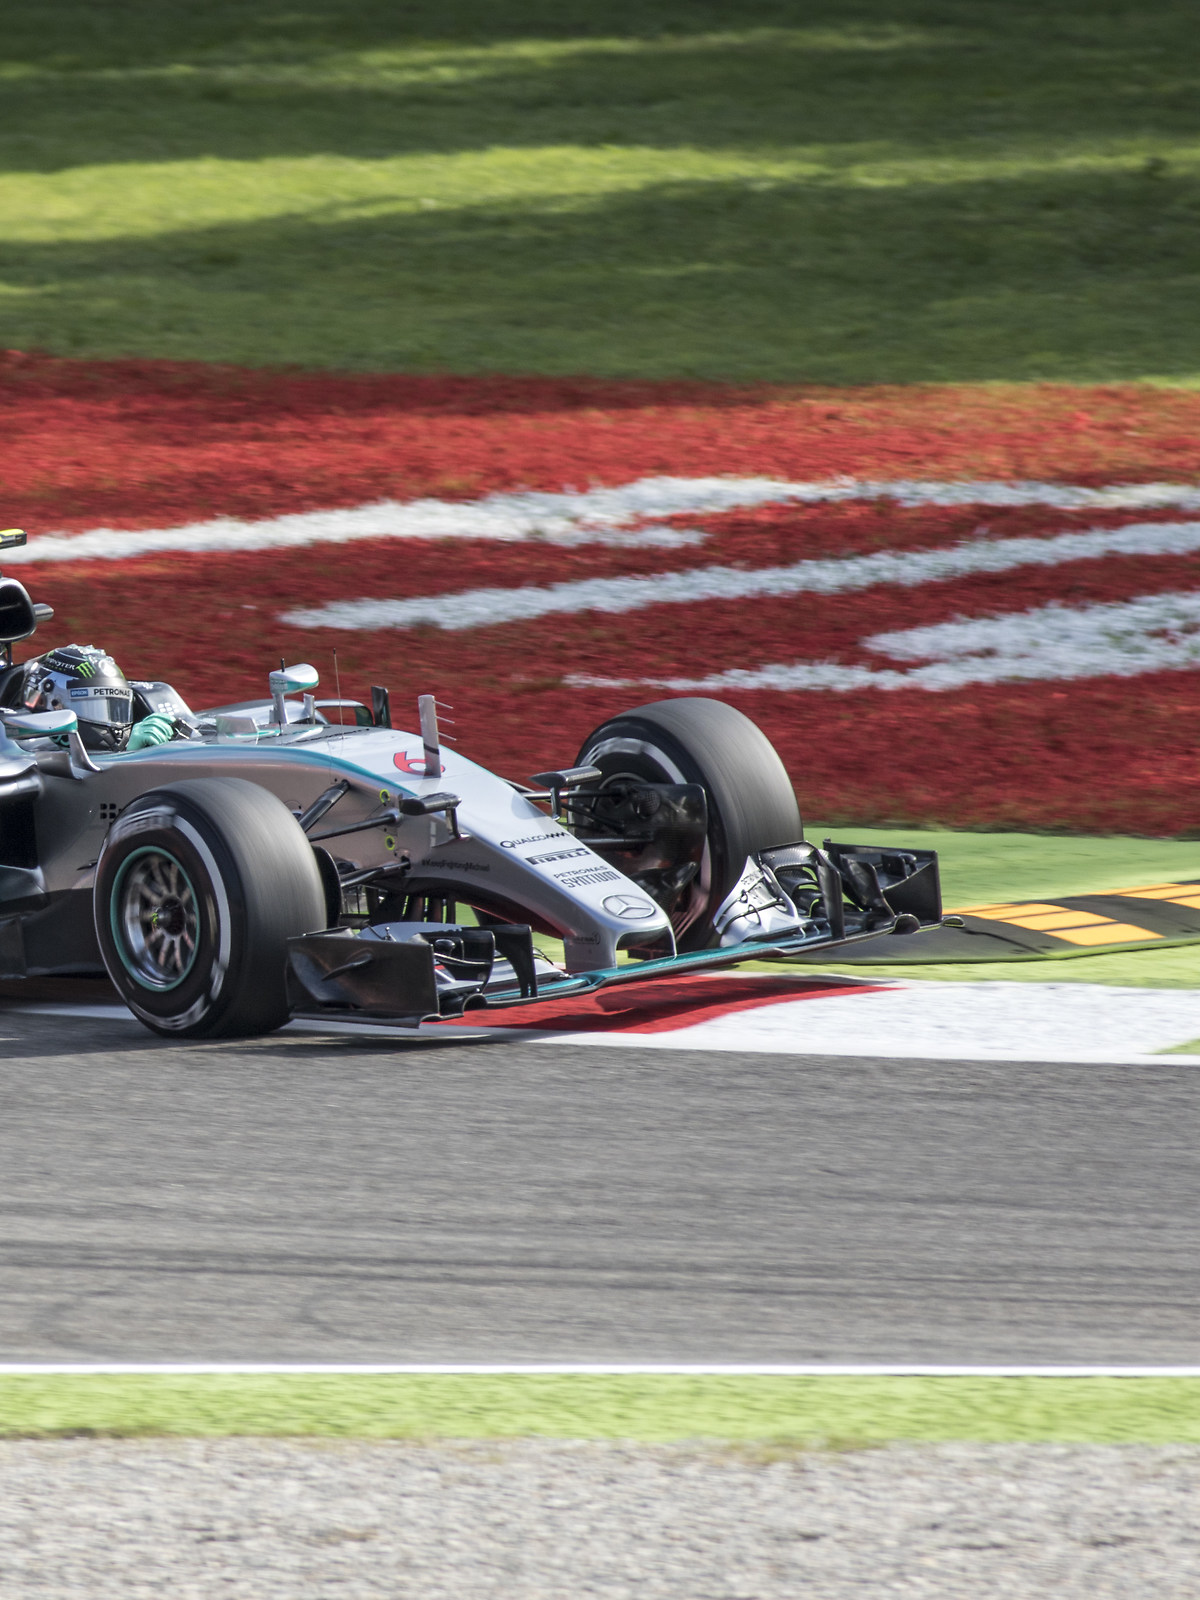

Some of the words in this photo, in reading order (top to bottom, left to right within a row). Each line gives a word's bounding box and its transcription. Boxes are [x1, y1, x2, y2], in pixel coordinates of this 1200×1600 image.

[93, 688, 131, 697] PETRONAS
[392, 751, 446, 777] 6
[525, 847, 592, 866] PIRELLI
[553, 865, 610, 880] PETRONAS
[561, 870, 622, 889] SYNTIUM
